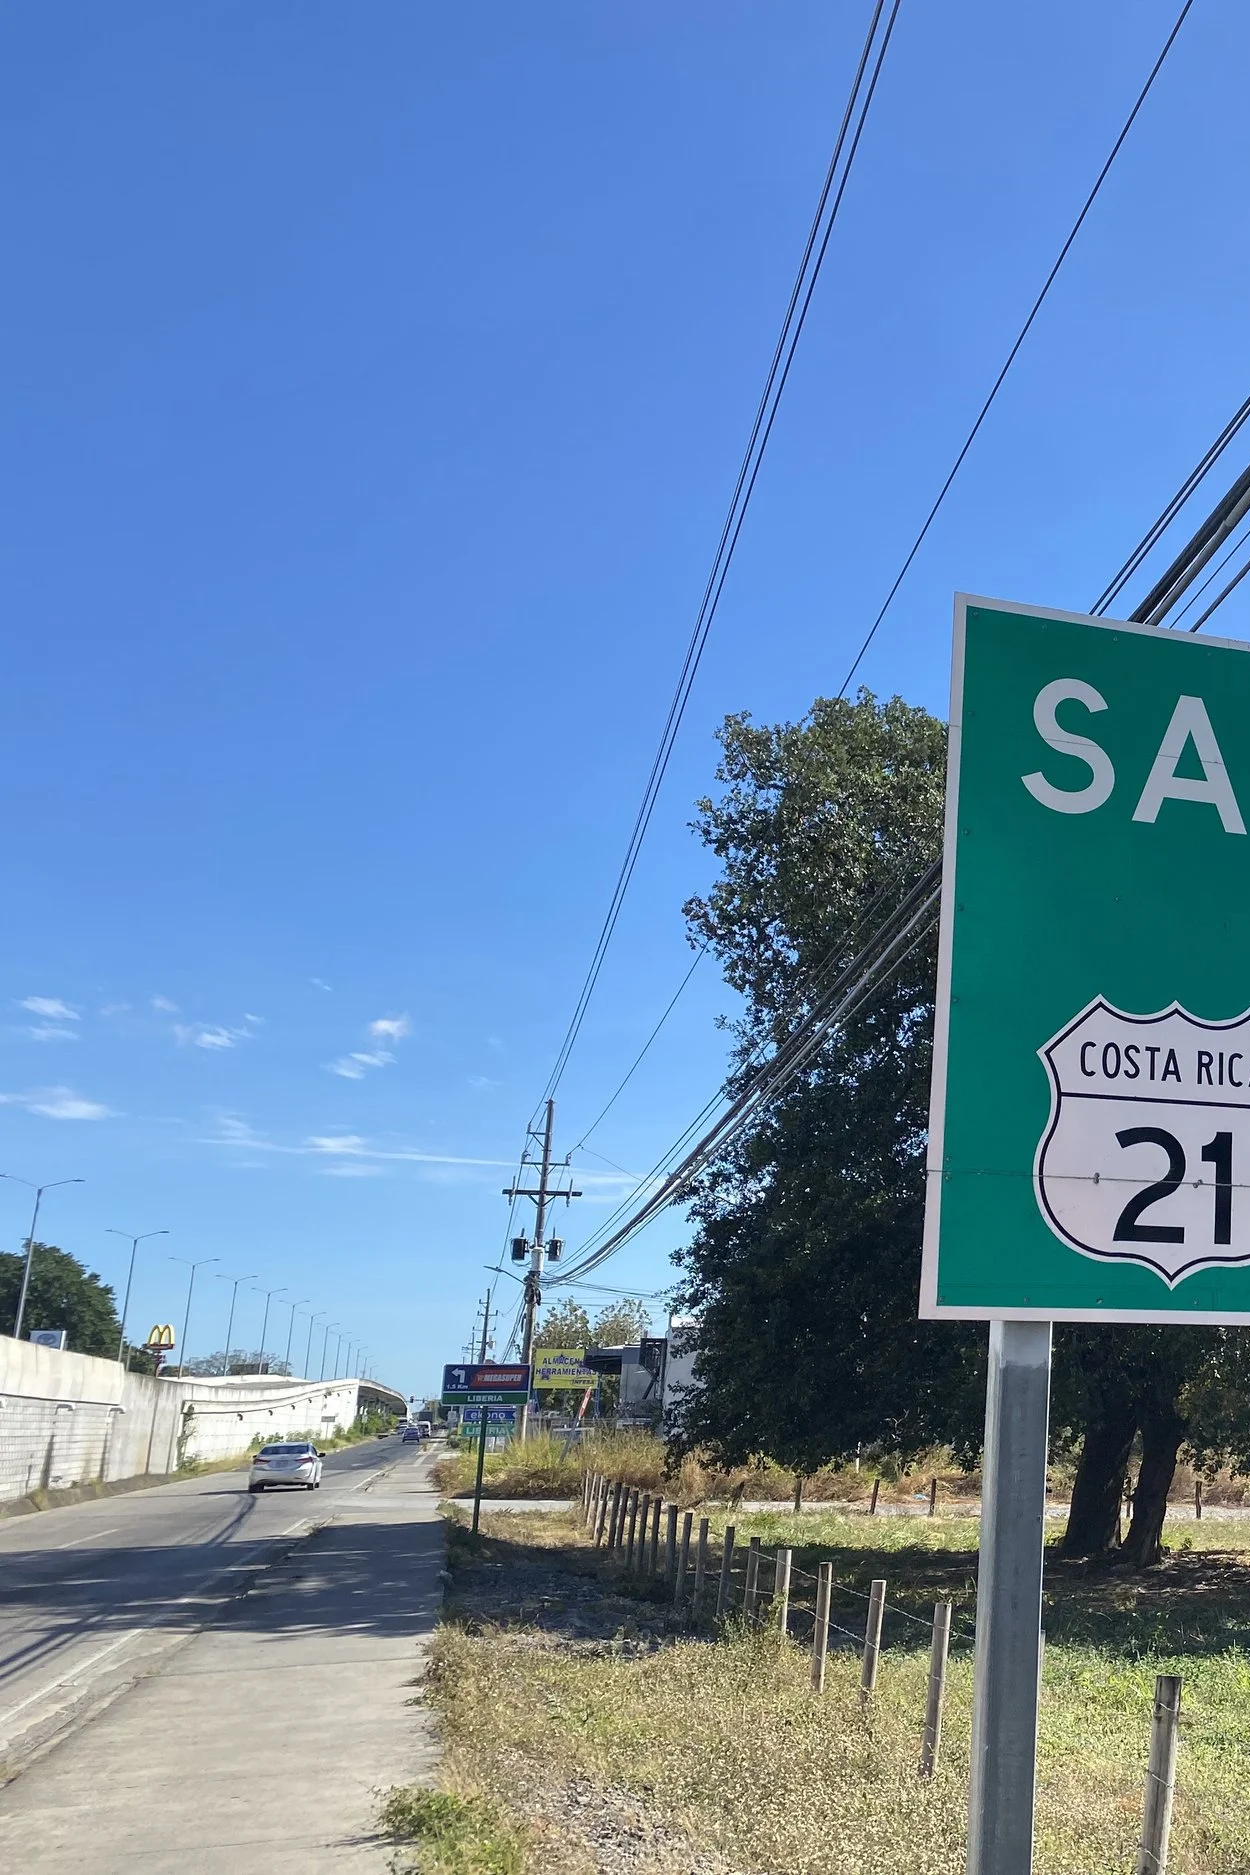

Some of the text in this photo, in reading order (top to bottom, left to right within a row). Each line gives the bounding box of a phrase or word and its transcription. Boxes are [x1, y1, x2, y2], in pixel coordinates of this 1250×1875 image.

[1080, 1041, 1182, 1083] COSTA
[1112, 1126, 1233, 1245] 21
[466, 1427, 506, 1435] LIBRIA
